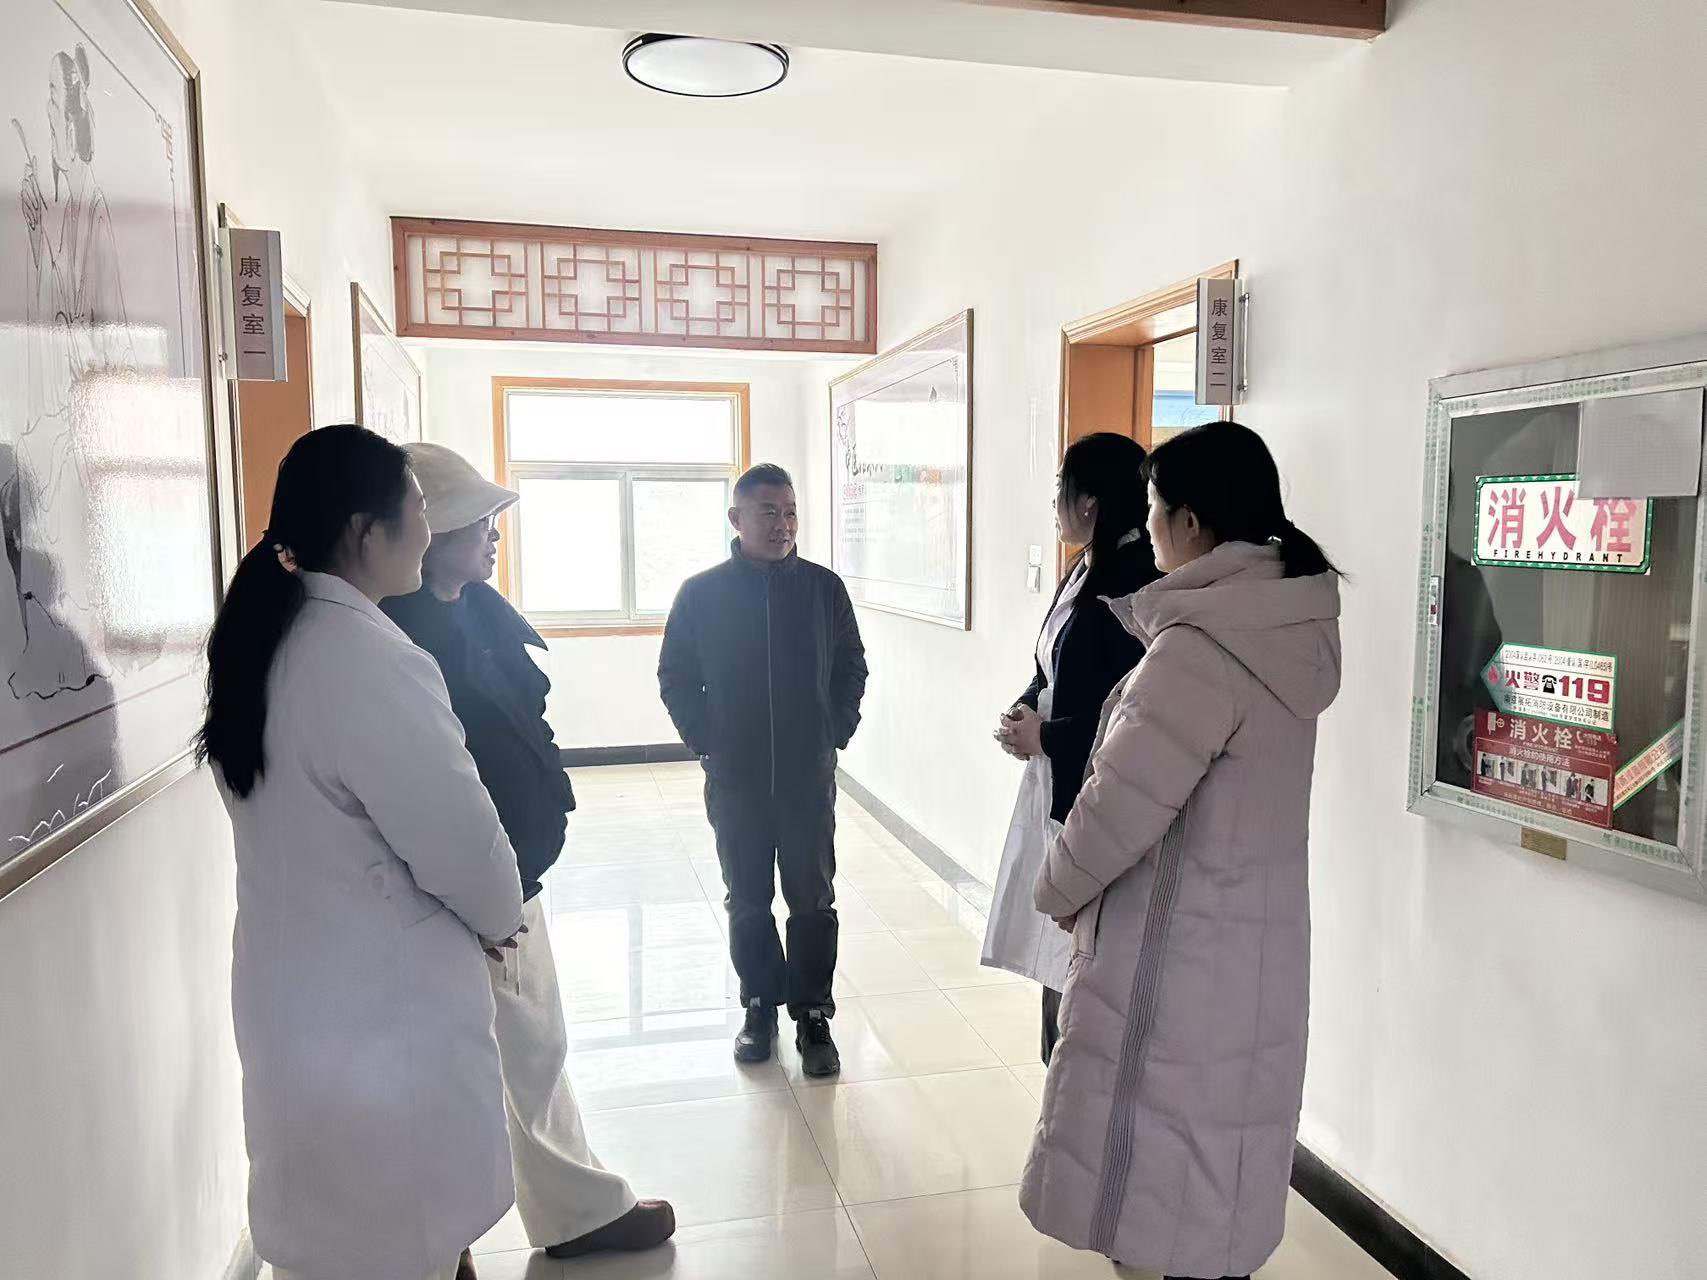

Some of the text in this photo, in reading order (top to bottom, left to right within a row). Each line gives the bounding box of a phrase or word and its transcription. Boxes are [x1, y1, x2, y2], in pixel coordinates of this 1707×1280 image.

[239, 256, 266, 355] 康复室一
[1210, 298, 1228, 386] 康复室二
[1488, 486, 1637, 552] 消火栓
[1504, 669, 1610, 704] 火警 119
[1509, 718, 1573, 750] 消火栓
